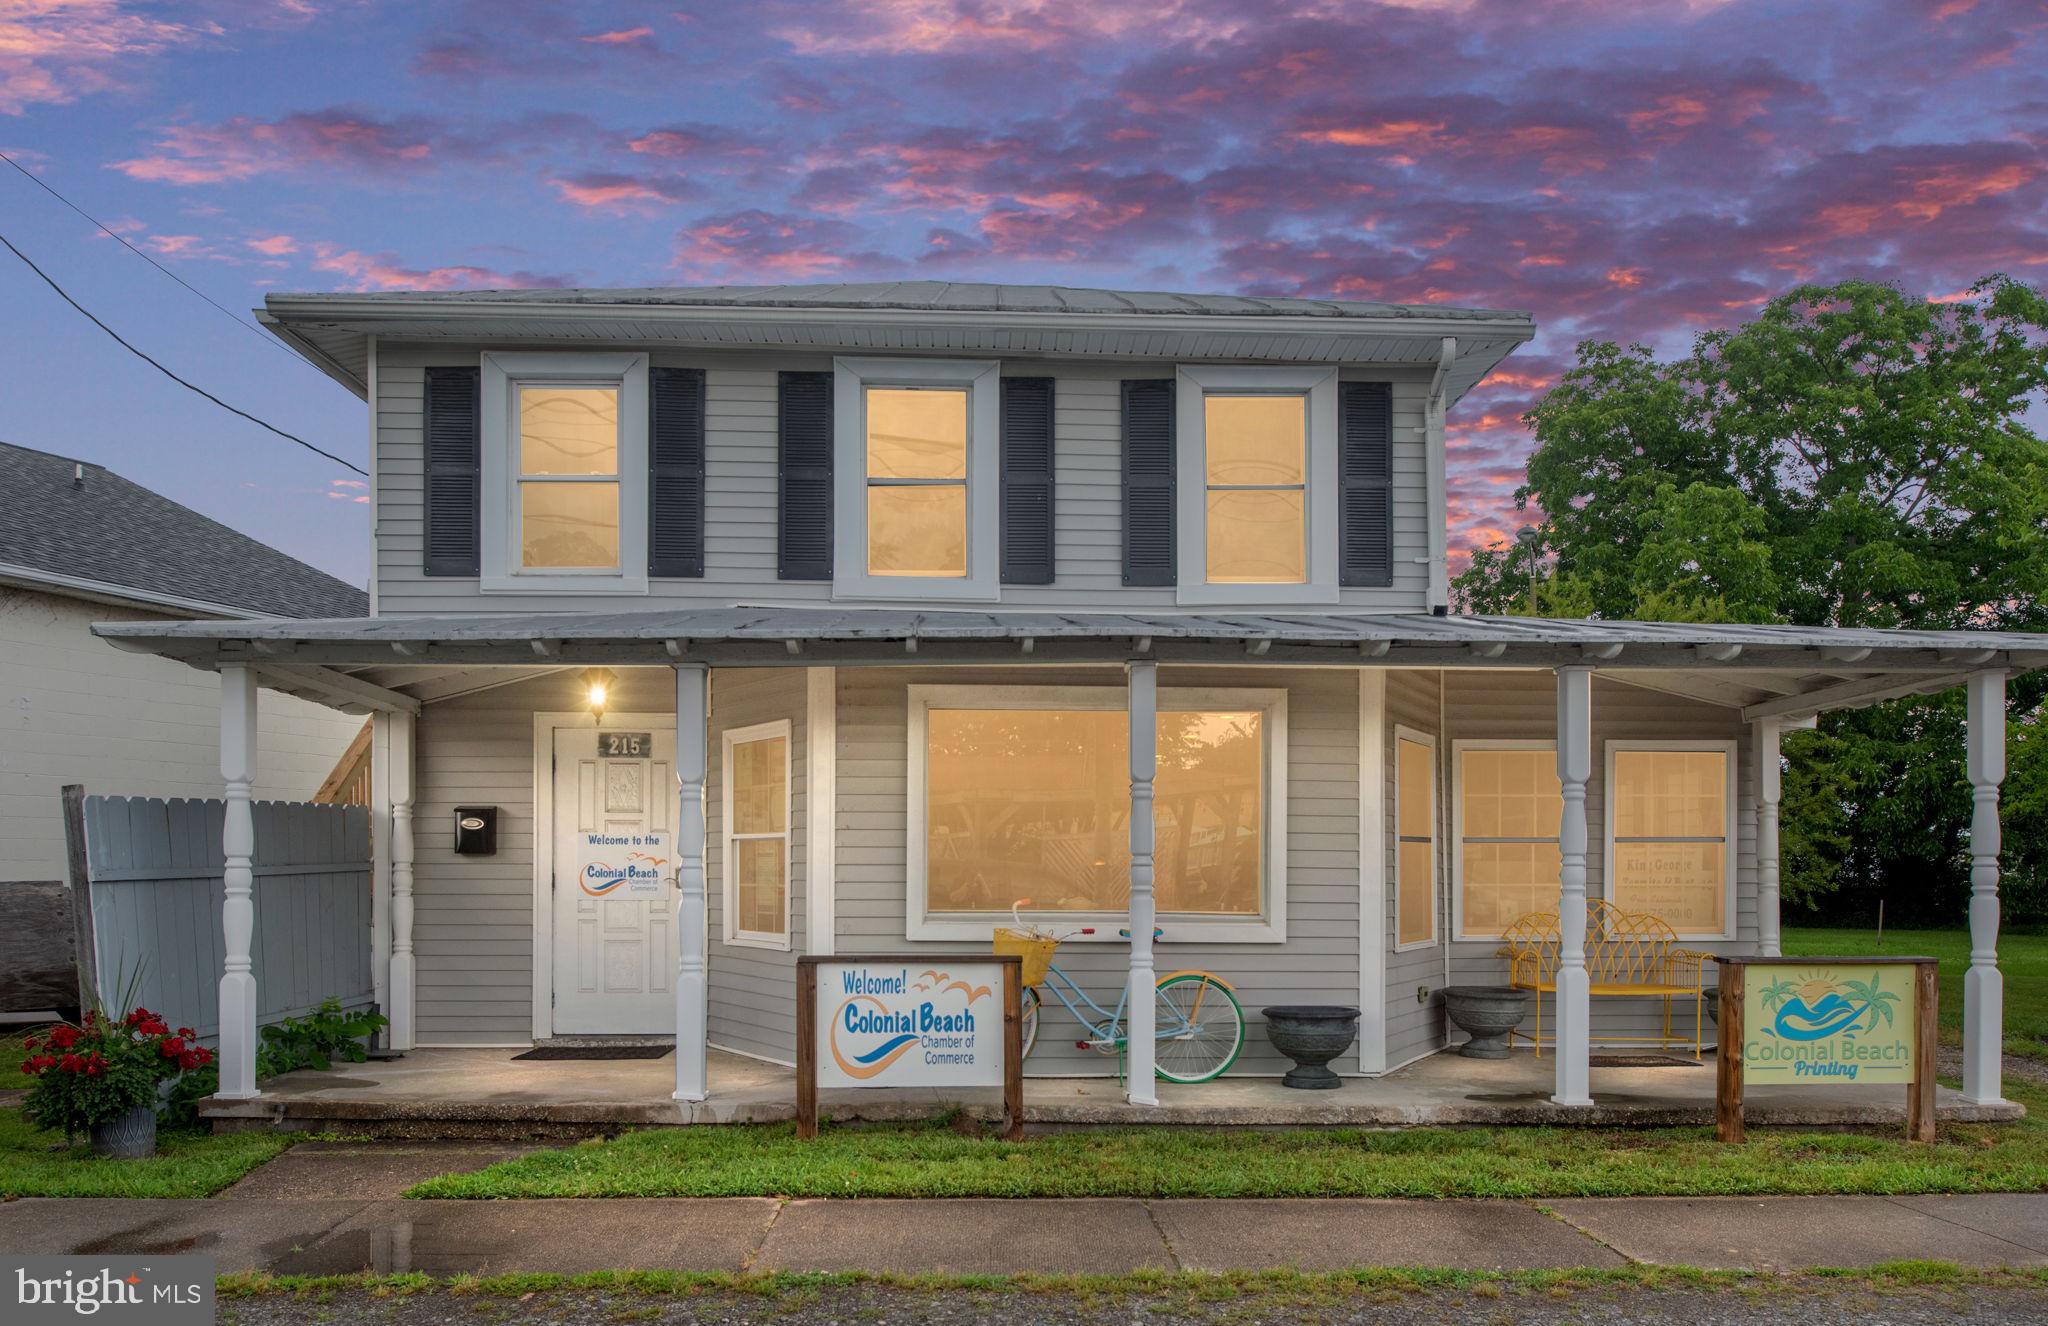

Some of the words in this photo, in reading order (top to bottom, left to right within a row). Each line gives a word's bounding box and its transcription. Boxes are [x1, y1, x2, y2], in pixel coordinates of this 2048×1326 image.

[609, 737, 640, 754] 215
[588, 834, 629, 846] Welcome
[632, 835, 641, 846] to
[645, 834, 660, 846] the
[587, 865, 627, 879] Colonial
[628, 865, 658, 878] Beach
[842, 969, 907, 994] Welcome!
[844, 1003, 916, 1034] Colonial
[919, 1002, 975, 1033] Beach
[921, 1034, 962, 1049] Chamber
[965, 1034, 975, 1048] of
[1744, 1040, 1834, 1061] Colonial
[1842, 1039, 1909, 1060] Beach
[925, 1051, 975, 1065] Commerce
[1793, 1060, 1859, 1080] Printing
